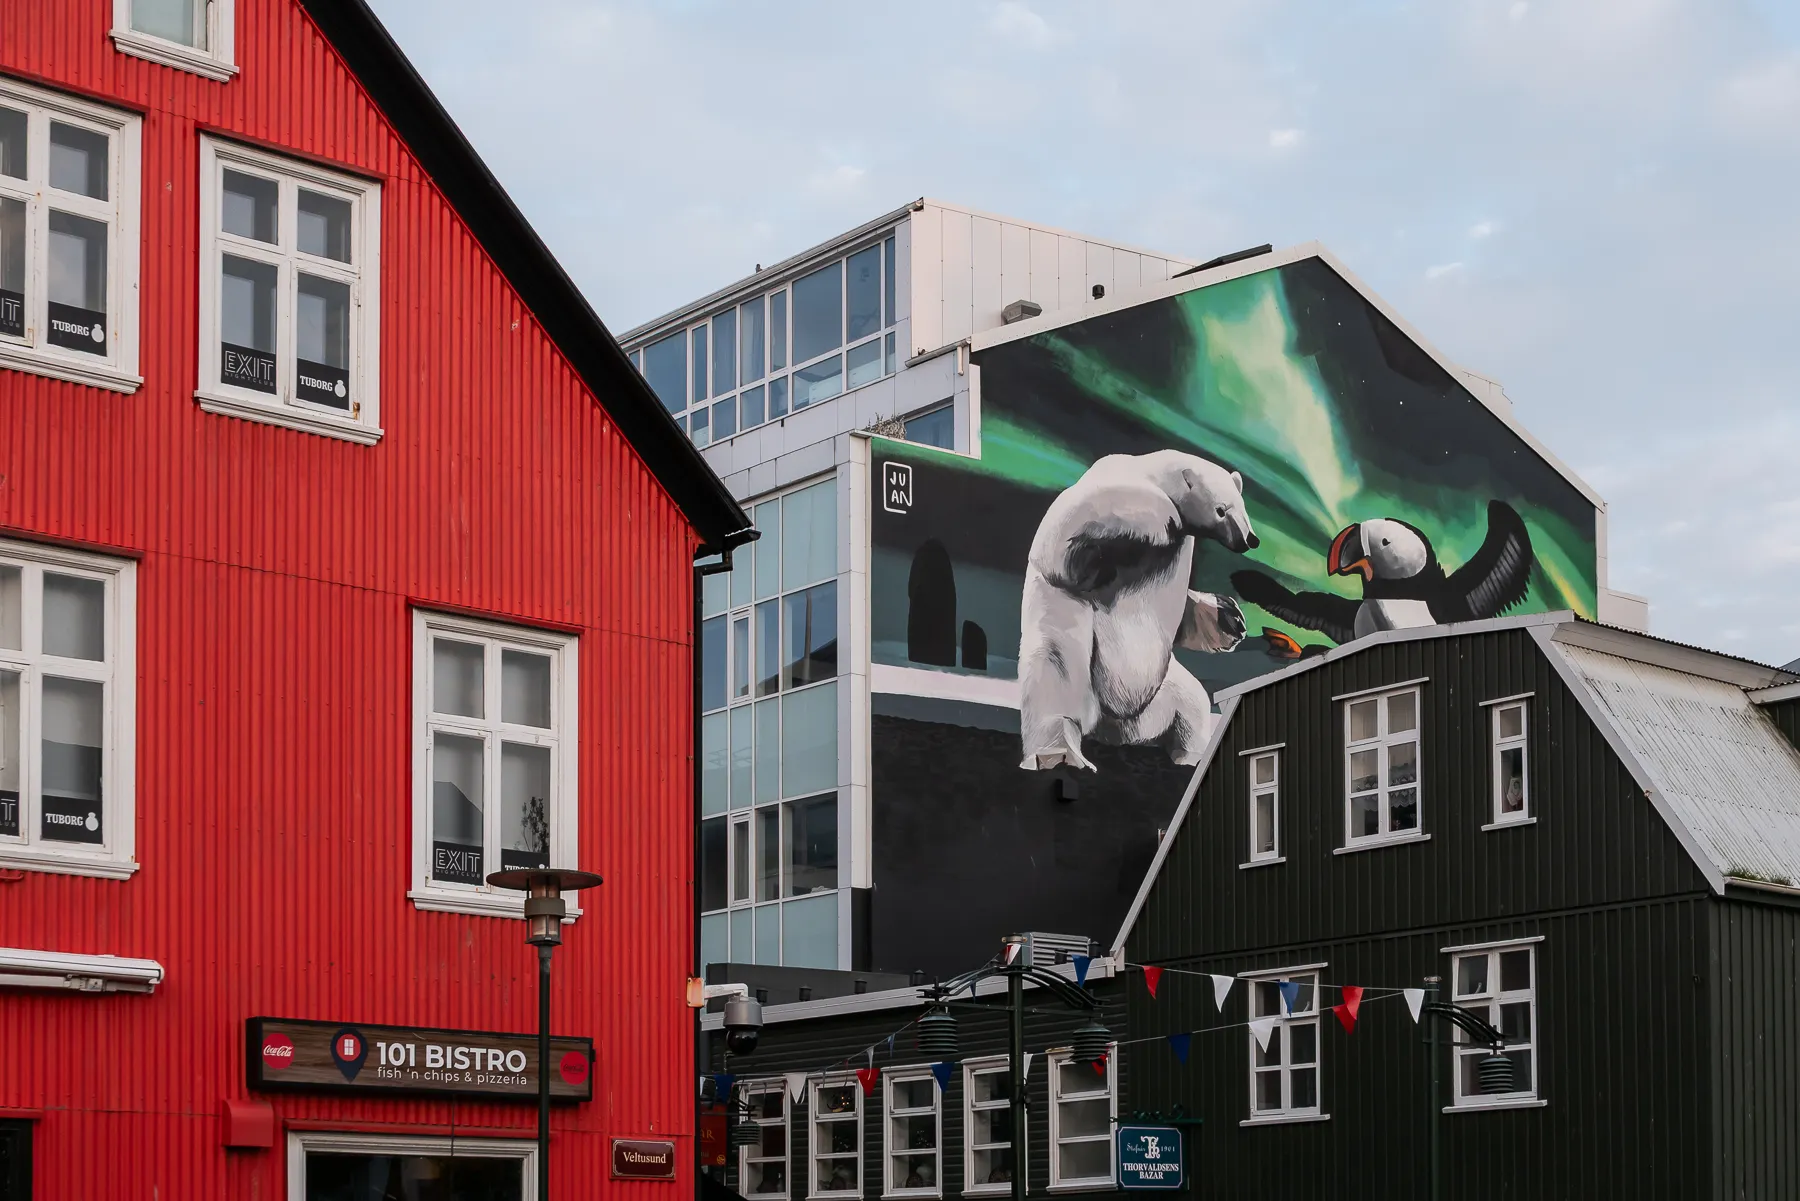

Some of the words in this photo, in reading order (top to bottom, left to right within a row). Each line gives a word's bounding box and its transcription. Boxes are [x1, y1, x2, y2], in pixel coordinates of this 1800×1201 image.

[51, 319, 90, 337] TUBORG
[224, 350, 274, 381] EXIT
[224, 371, 274, 387] NIGHTCLUB
[299, 375, 333, 391] TUBORG
[45, 812, 84, 826] TUBORG
[435, 848, 480, 873] EXIT
[435, 868, 480, 879] NIGHTCLUB
[376, 1042, 416, 1067] 101
[425, 1044, 527, 1073] BISTRO
[377, 1066, 402, 1078] fish
[424, 1069, 460, 1083] chips
[464, 1071, 473, 1082] &
[477, 1072, 527, 1085] pizzeria
[623, 1151, 667, 1164] Veltusund
[1122, 1162, 1179, 1172] THORVALDSENS
[1139, 1171, 1164, 1180] BAZAR
